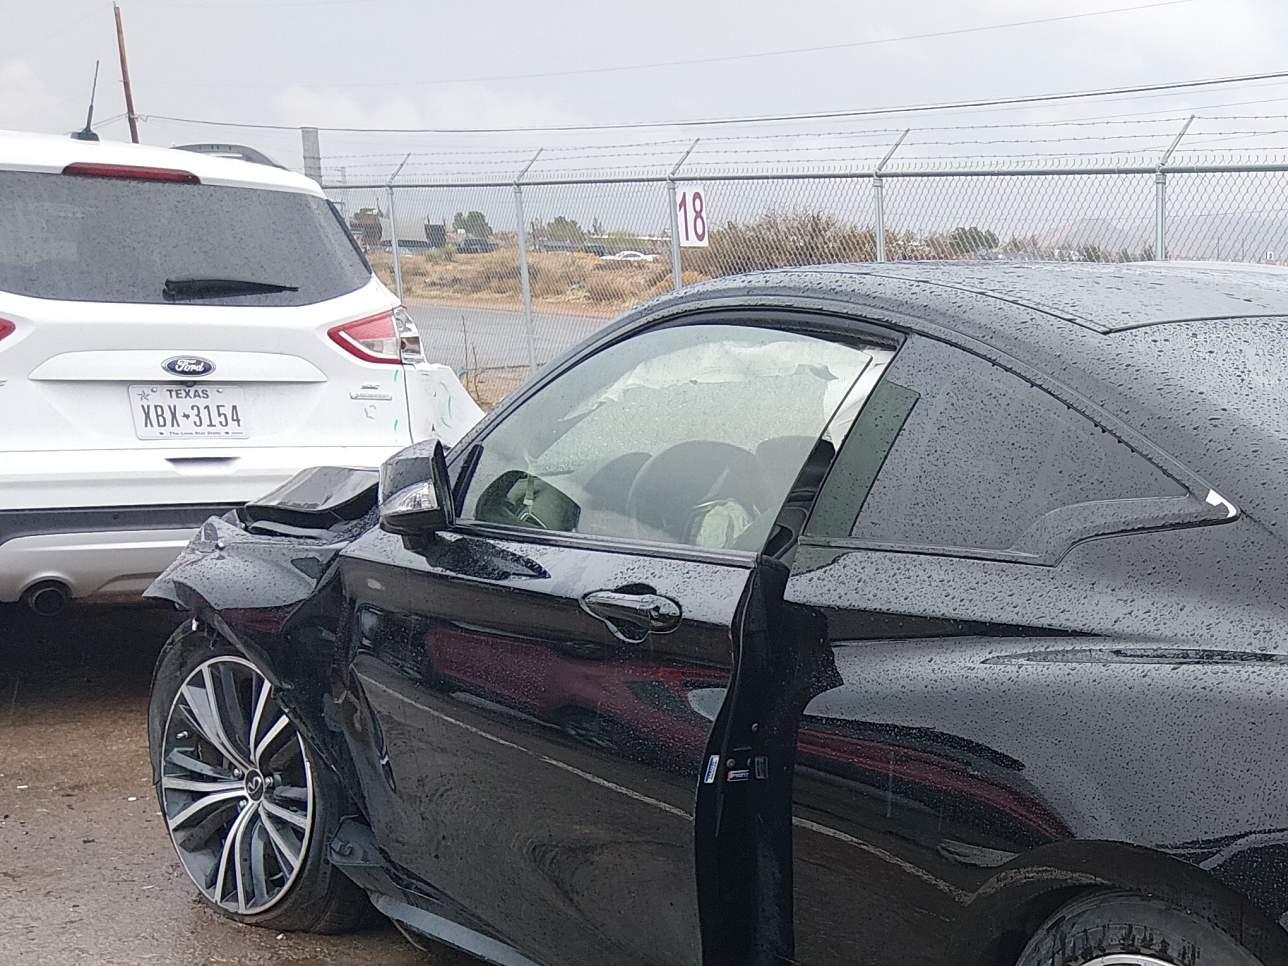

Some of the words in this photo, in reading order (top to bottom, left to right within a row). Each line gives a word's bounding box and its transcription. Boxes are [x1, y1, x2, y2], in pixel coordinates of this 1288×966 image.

[678, 191, 706, 242] 18
[175, 358, 205, 372] Ford
[165, 388, 210, 399] TEXAS
[190, 403, 241, 428] 3154
